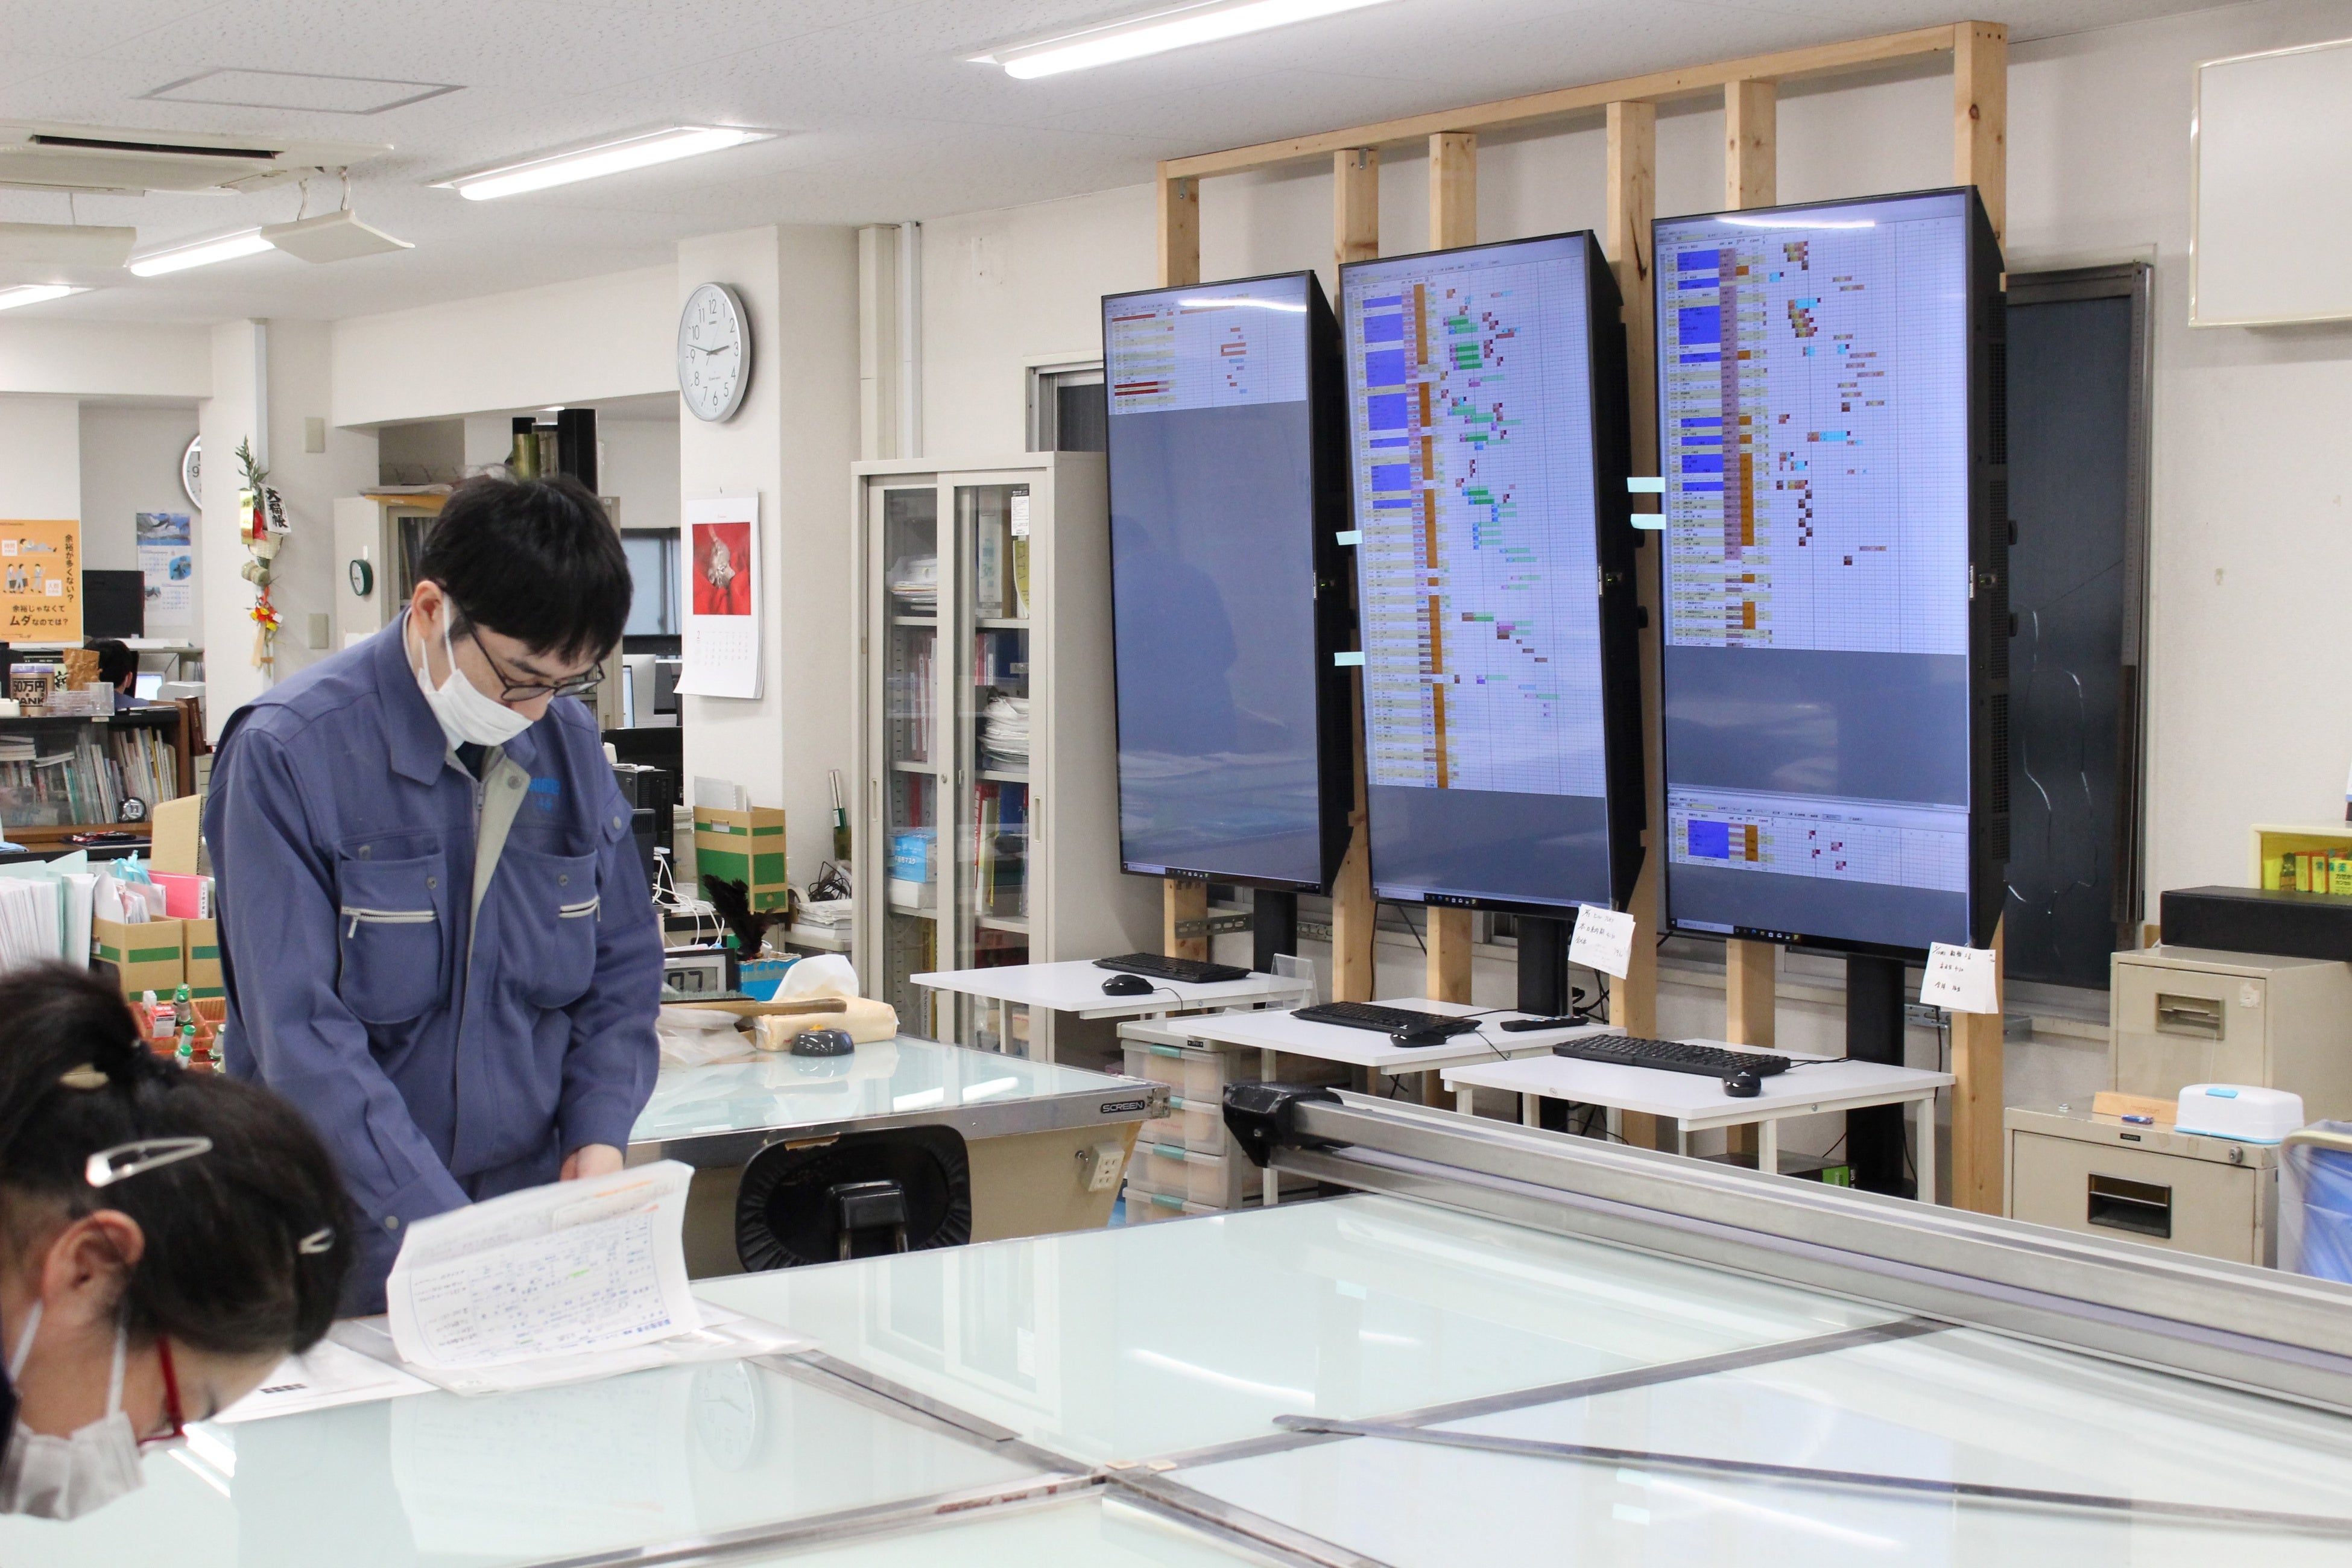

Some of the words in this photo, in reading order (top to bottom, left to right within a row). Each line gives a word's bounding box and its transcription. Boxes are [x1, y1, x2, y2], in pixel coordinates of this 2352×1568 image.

[709, 299, 717, 314] 12
[722, 303, 726, 318] 1
[698, 308, 705, 323] 11
[691, 324, 700, 340] 10
[729, 318, 735, 333] 2
[734, 341, 739, 356] 3
[691, 349, 695, 364] 9
[694, 371, 700, 386] 8
[730, 365, 736, 380] 4
[703, 387, 708, 402] 7
[724, 382, 729, 397] 5
[713, 391, 718, 406] 6
[192, 466, 200, 478] 9
[10, 615, 68, 626] ムダなのでは？
[1102, 1101, 1144, 1113] SCREEN
